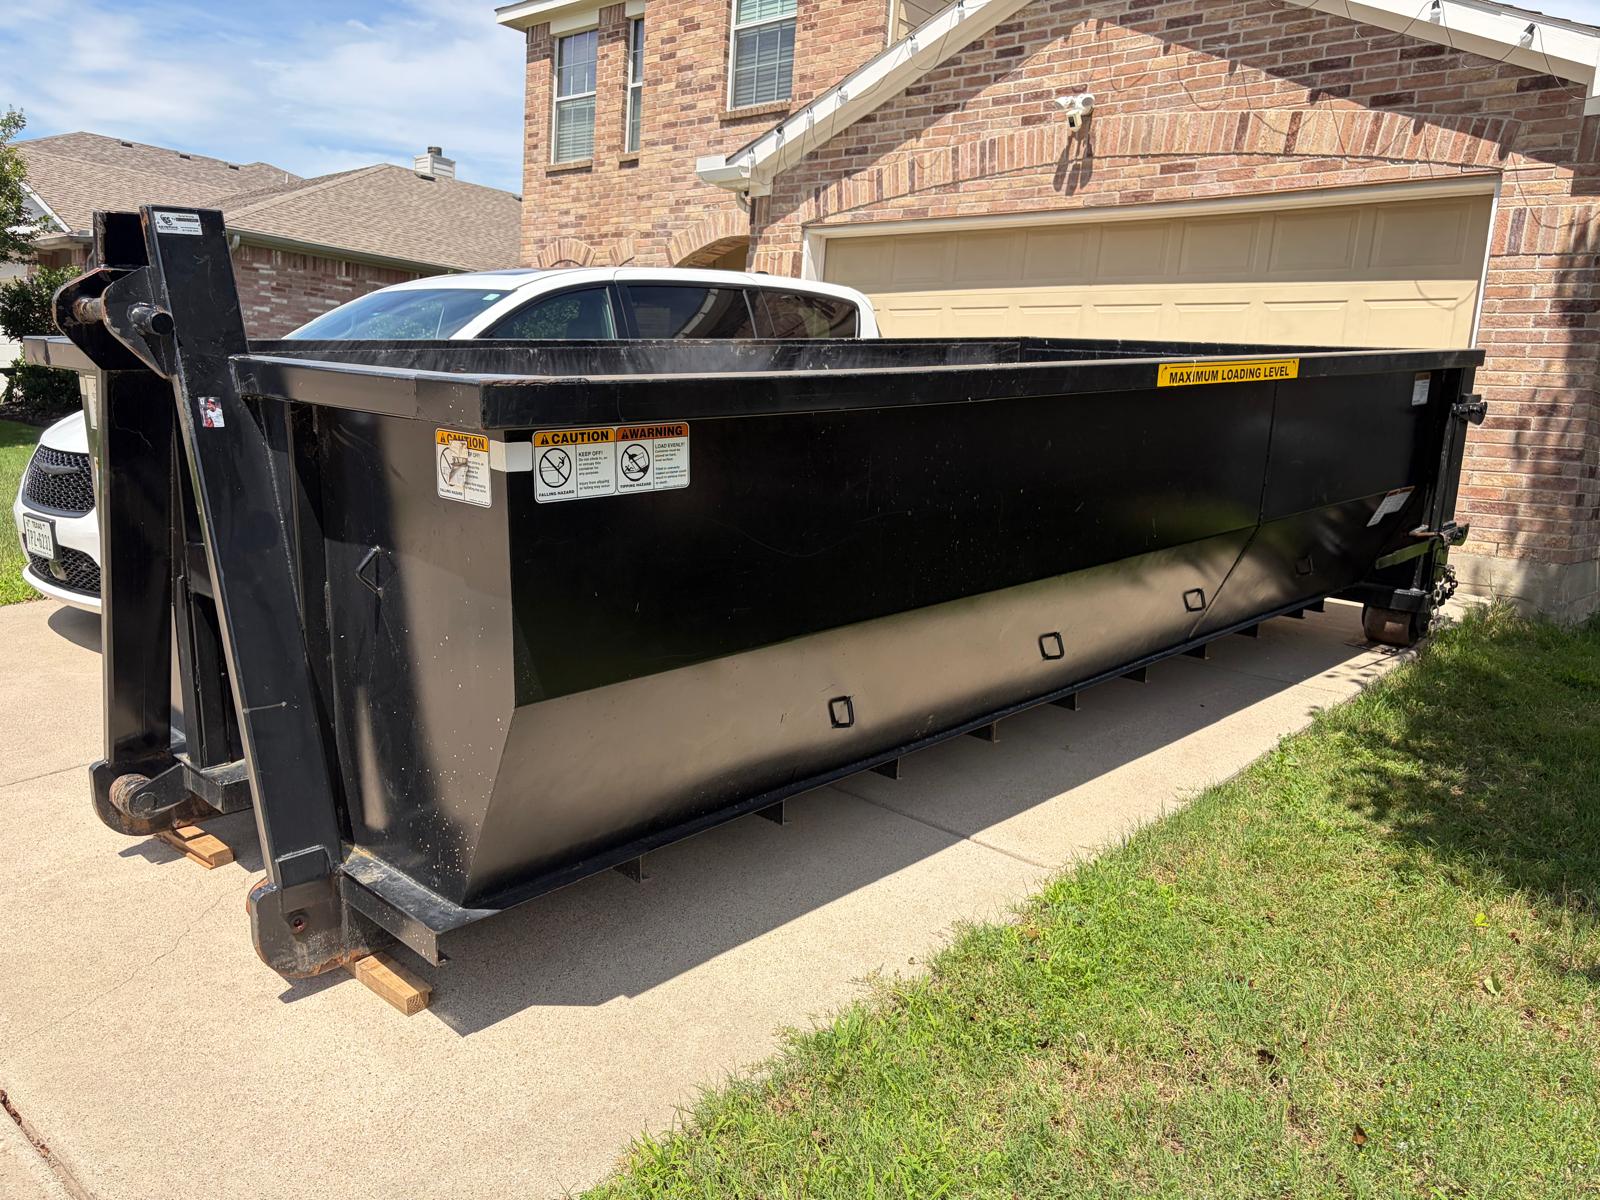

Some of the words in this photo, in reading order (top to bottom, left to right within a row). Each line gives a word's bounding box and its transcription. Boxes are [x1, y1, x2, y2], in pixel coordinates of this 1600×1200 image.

[1169, 370, 1218, 384] MAXIMUM
[1221, 368, 1261, 380] LOADING
[1263, 366, 1290, 378] LEVEL
[552, 430, 608, 444] CAUTION
[628, 426, 682, 438] WARNING
[32, 521, 42, 530] TEXAS
